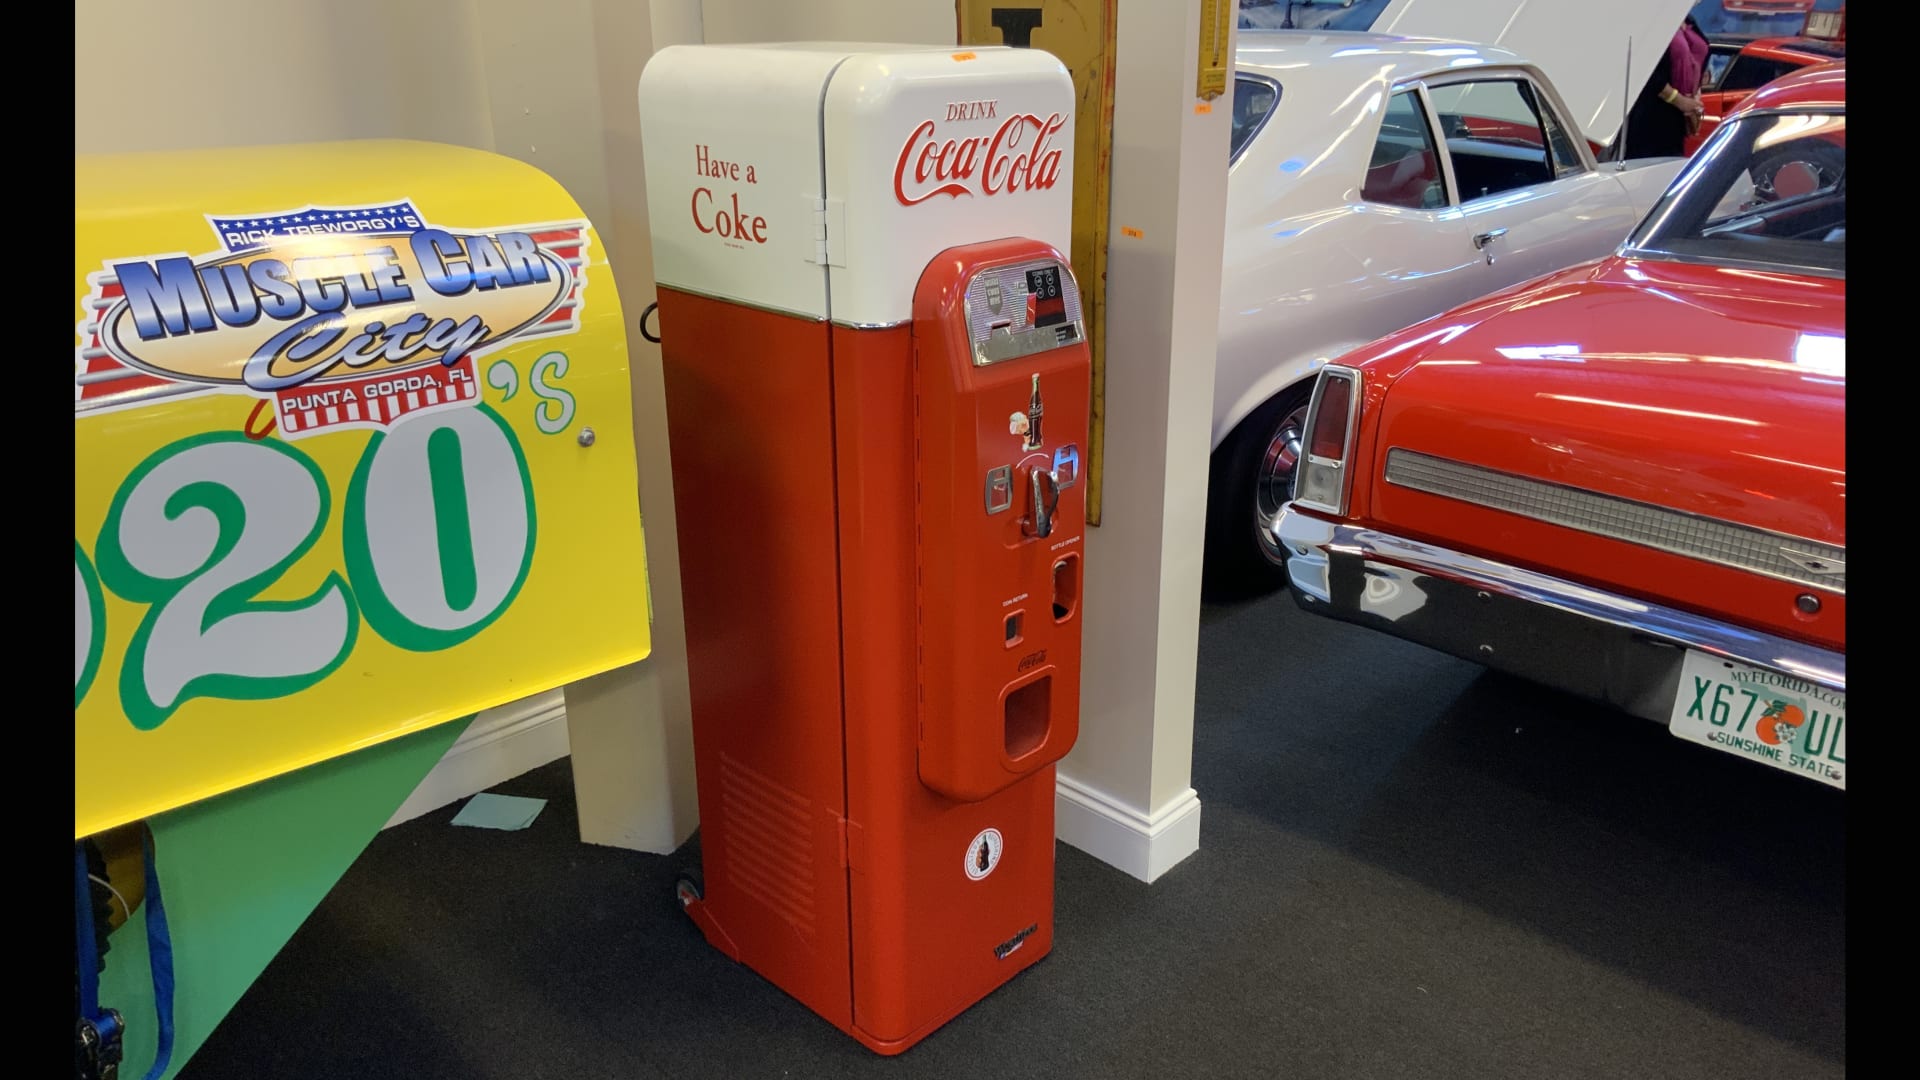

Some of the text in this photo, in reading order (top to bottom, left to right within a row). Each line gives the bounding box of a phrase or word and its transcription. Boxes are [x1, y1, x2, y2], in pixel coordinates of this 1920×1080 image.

[945, 100, 999, 122] DRINK
[695, 144, 758, 185] Have a
[894, 112, 1069, 207] Coca-Cola
[226, 228, 275, 247] RICK
[691, 187, 768, 244] Coke
[242, 311, 491, 391] City
[283, 368, 472, 414] PUNTA GORDA, FL
[1686, 675, 1759, 733] X67
[1715, 731, 1832, 778] SUNSHINE STATE
